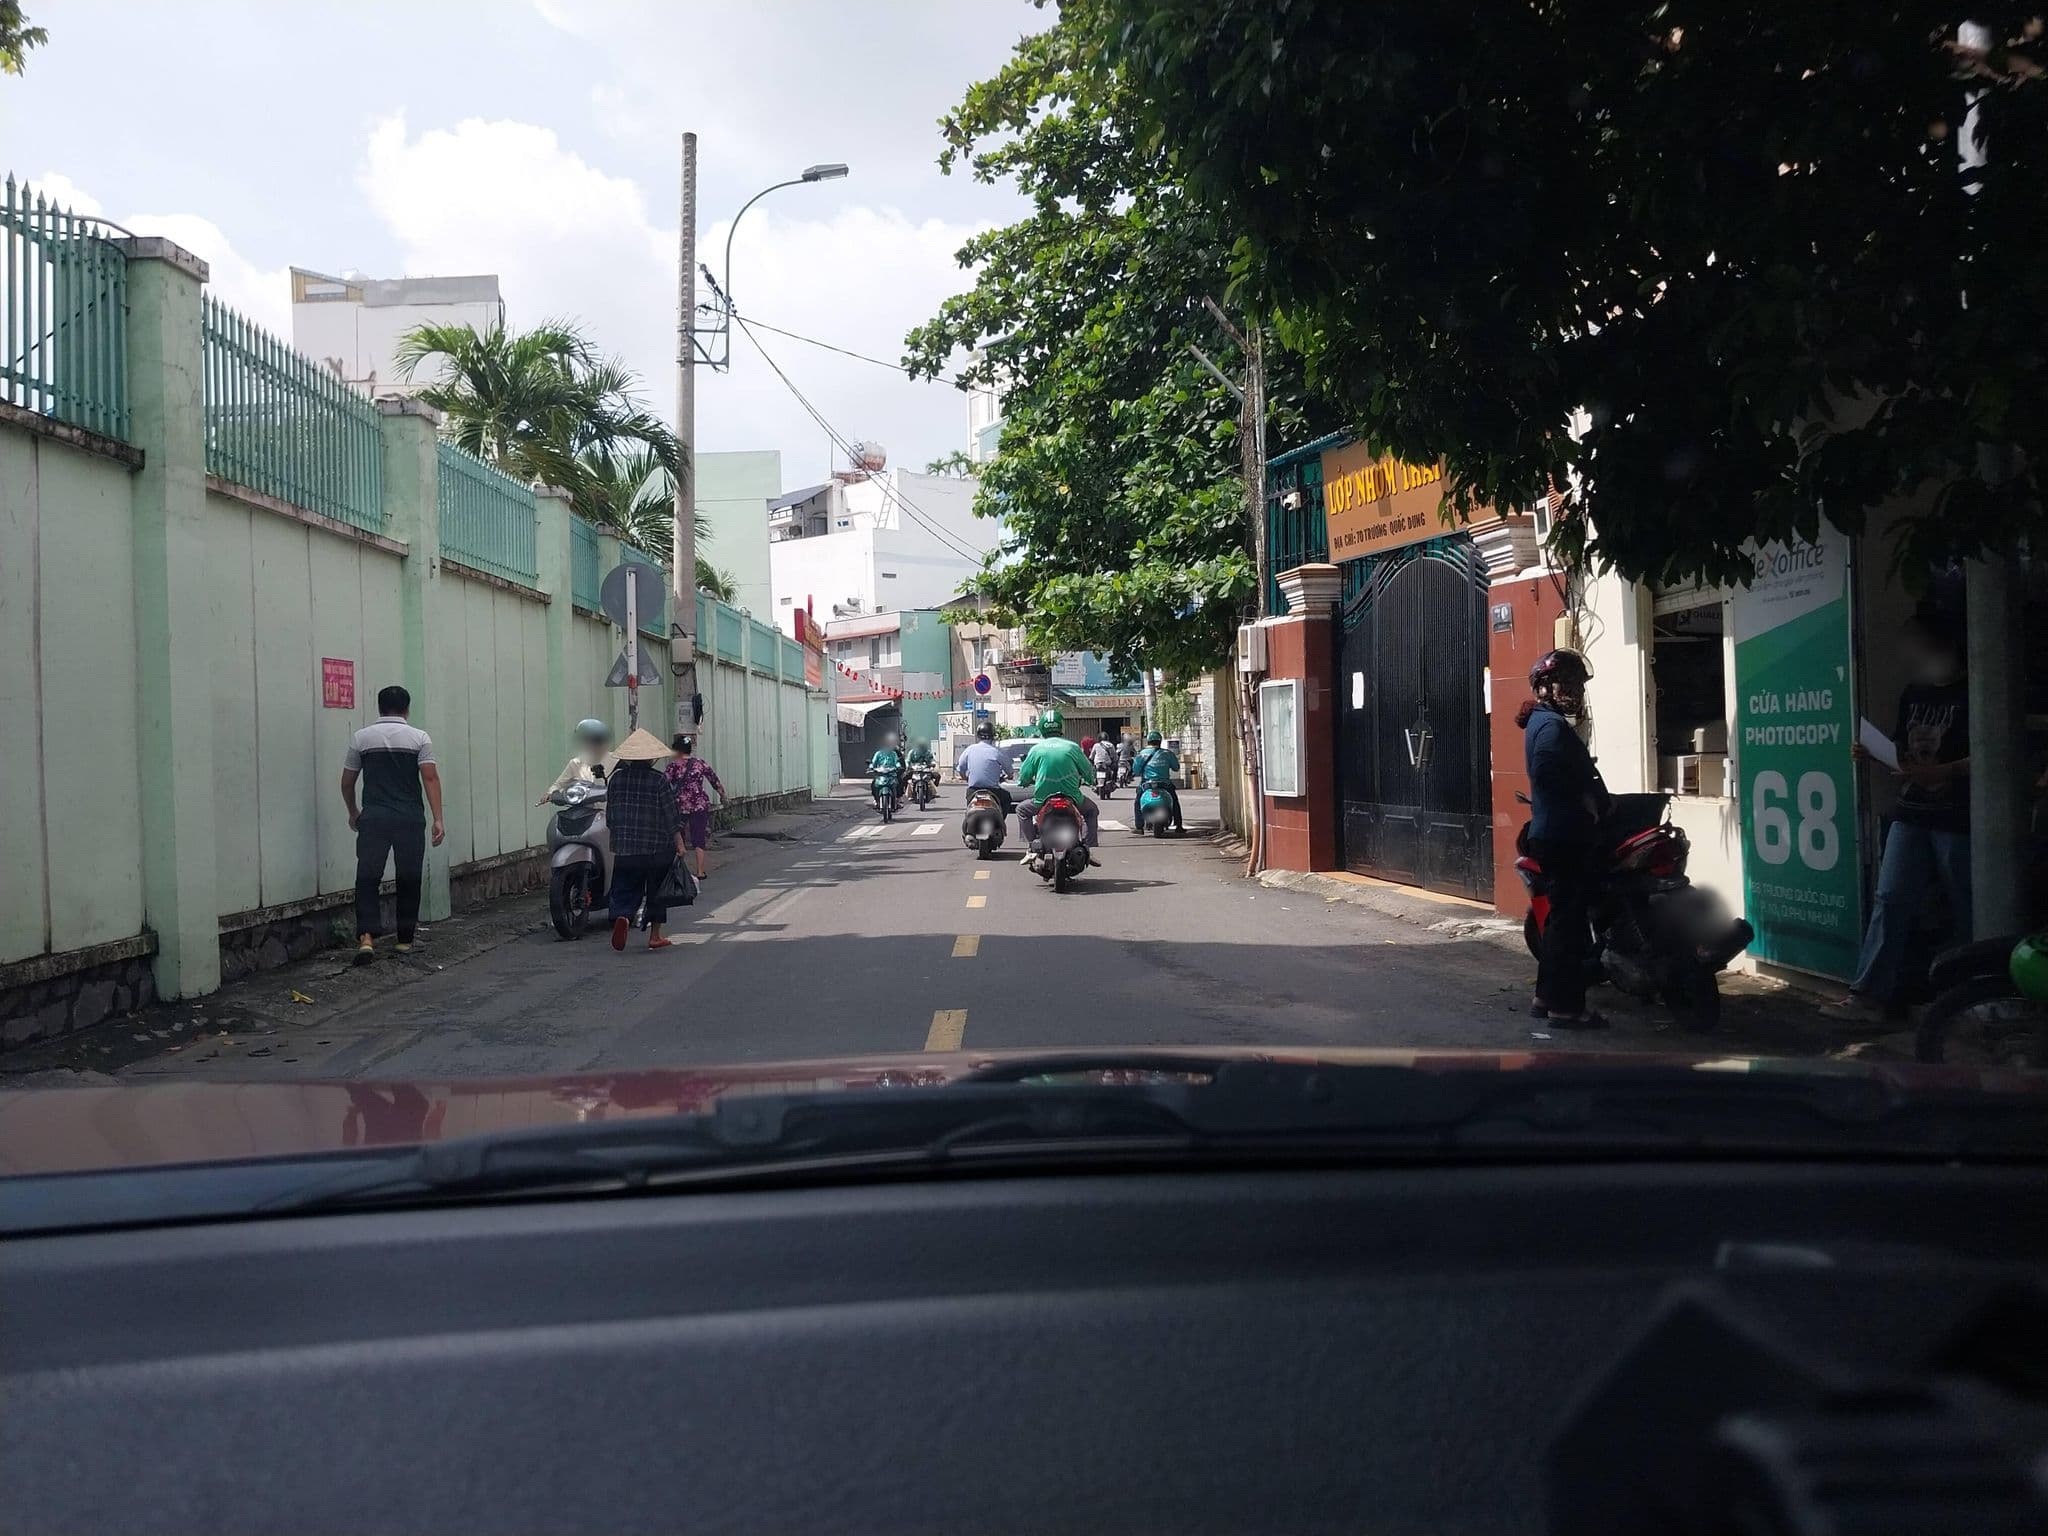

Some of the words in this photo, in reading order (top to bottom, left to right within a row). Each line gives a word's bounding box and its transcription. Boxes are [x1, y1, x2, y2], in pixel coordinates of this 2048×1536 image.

[1327, 465, 1354, 516] LỚP
[1749, 688, 1781, 715] CỬA
[1785, 685, 1833, 713] HÀNG
[1745, 722, 1841, 747] PHOTOCOPY
[1751, 769, 1841, 872] 68
